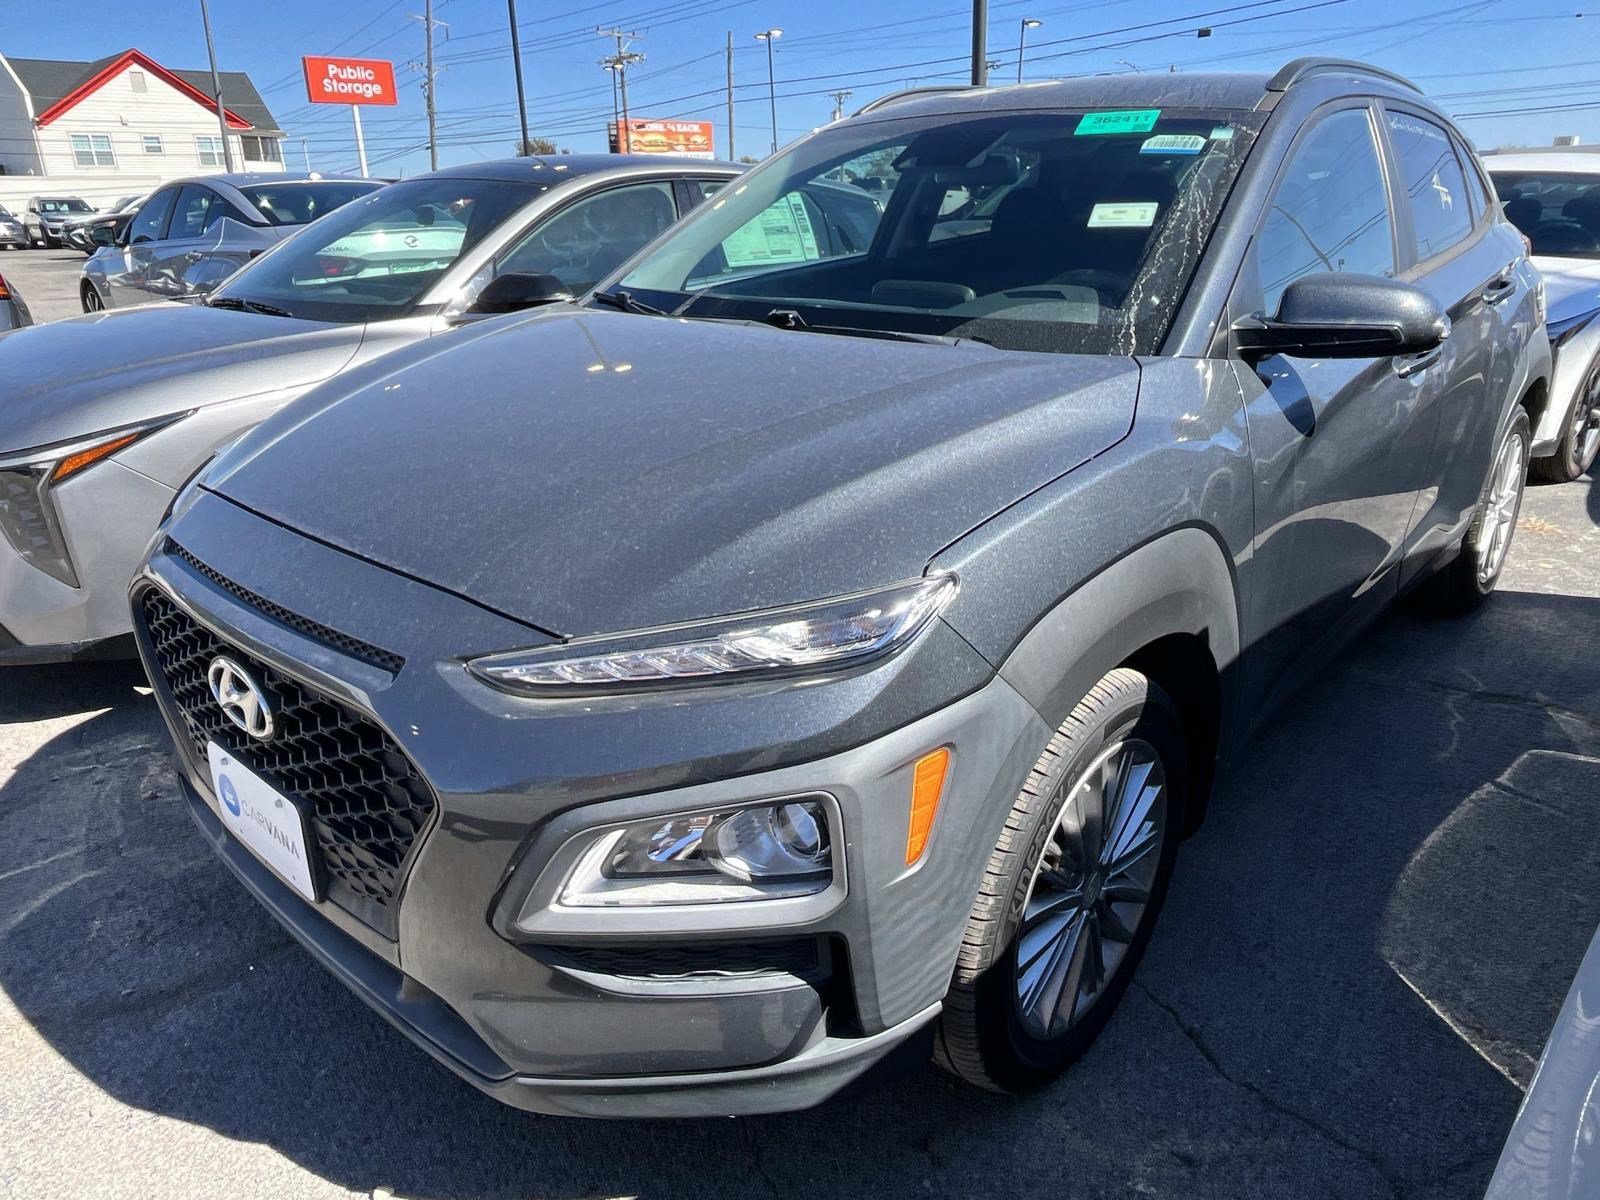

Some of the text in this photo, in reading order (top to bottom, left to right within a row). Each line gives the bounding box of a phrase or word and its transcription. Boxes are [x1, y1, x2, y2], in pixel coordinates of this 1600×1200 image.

[327, 64, 375, 81] Public
[323, 78, 382, 97] Storage
[1093, 114, 1150, 125] 362411
[240, 799, 301, 860] CARVANA
